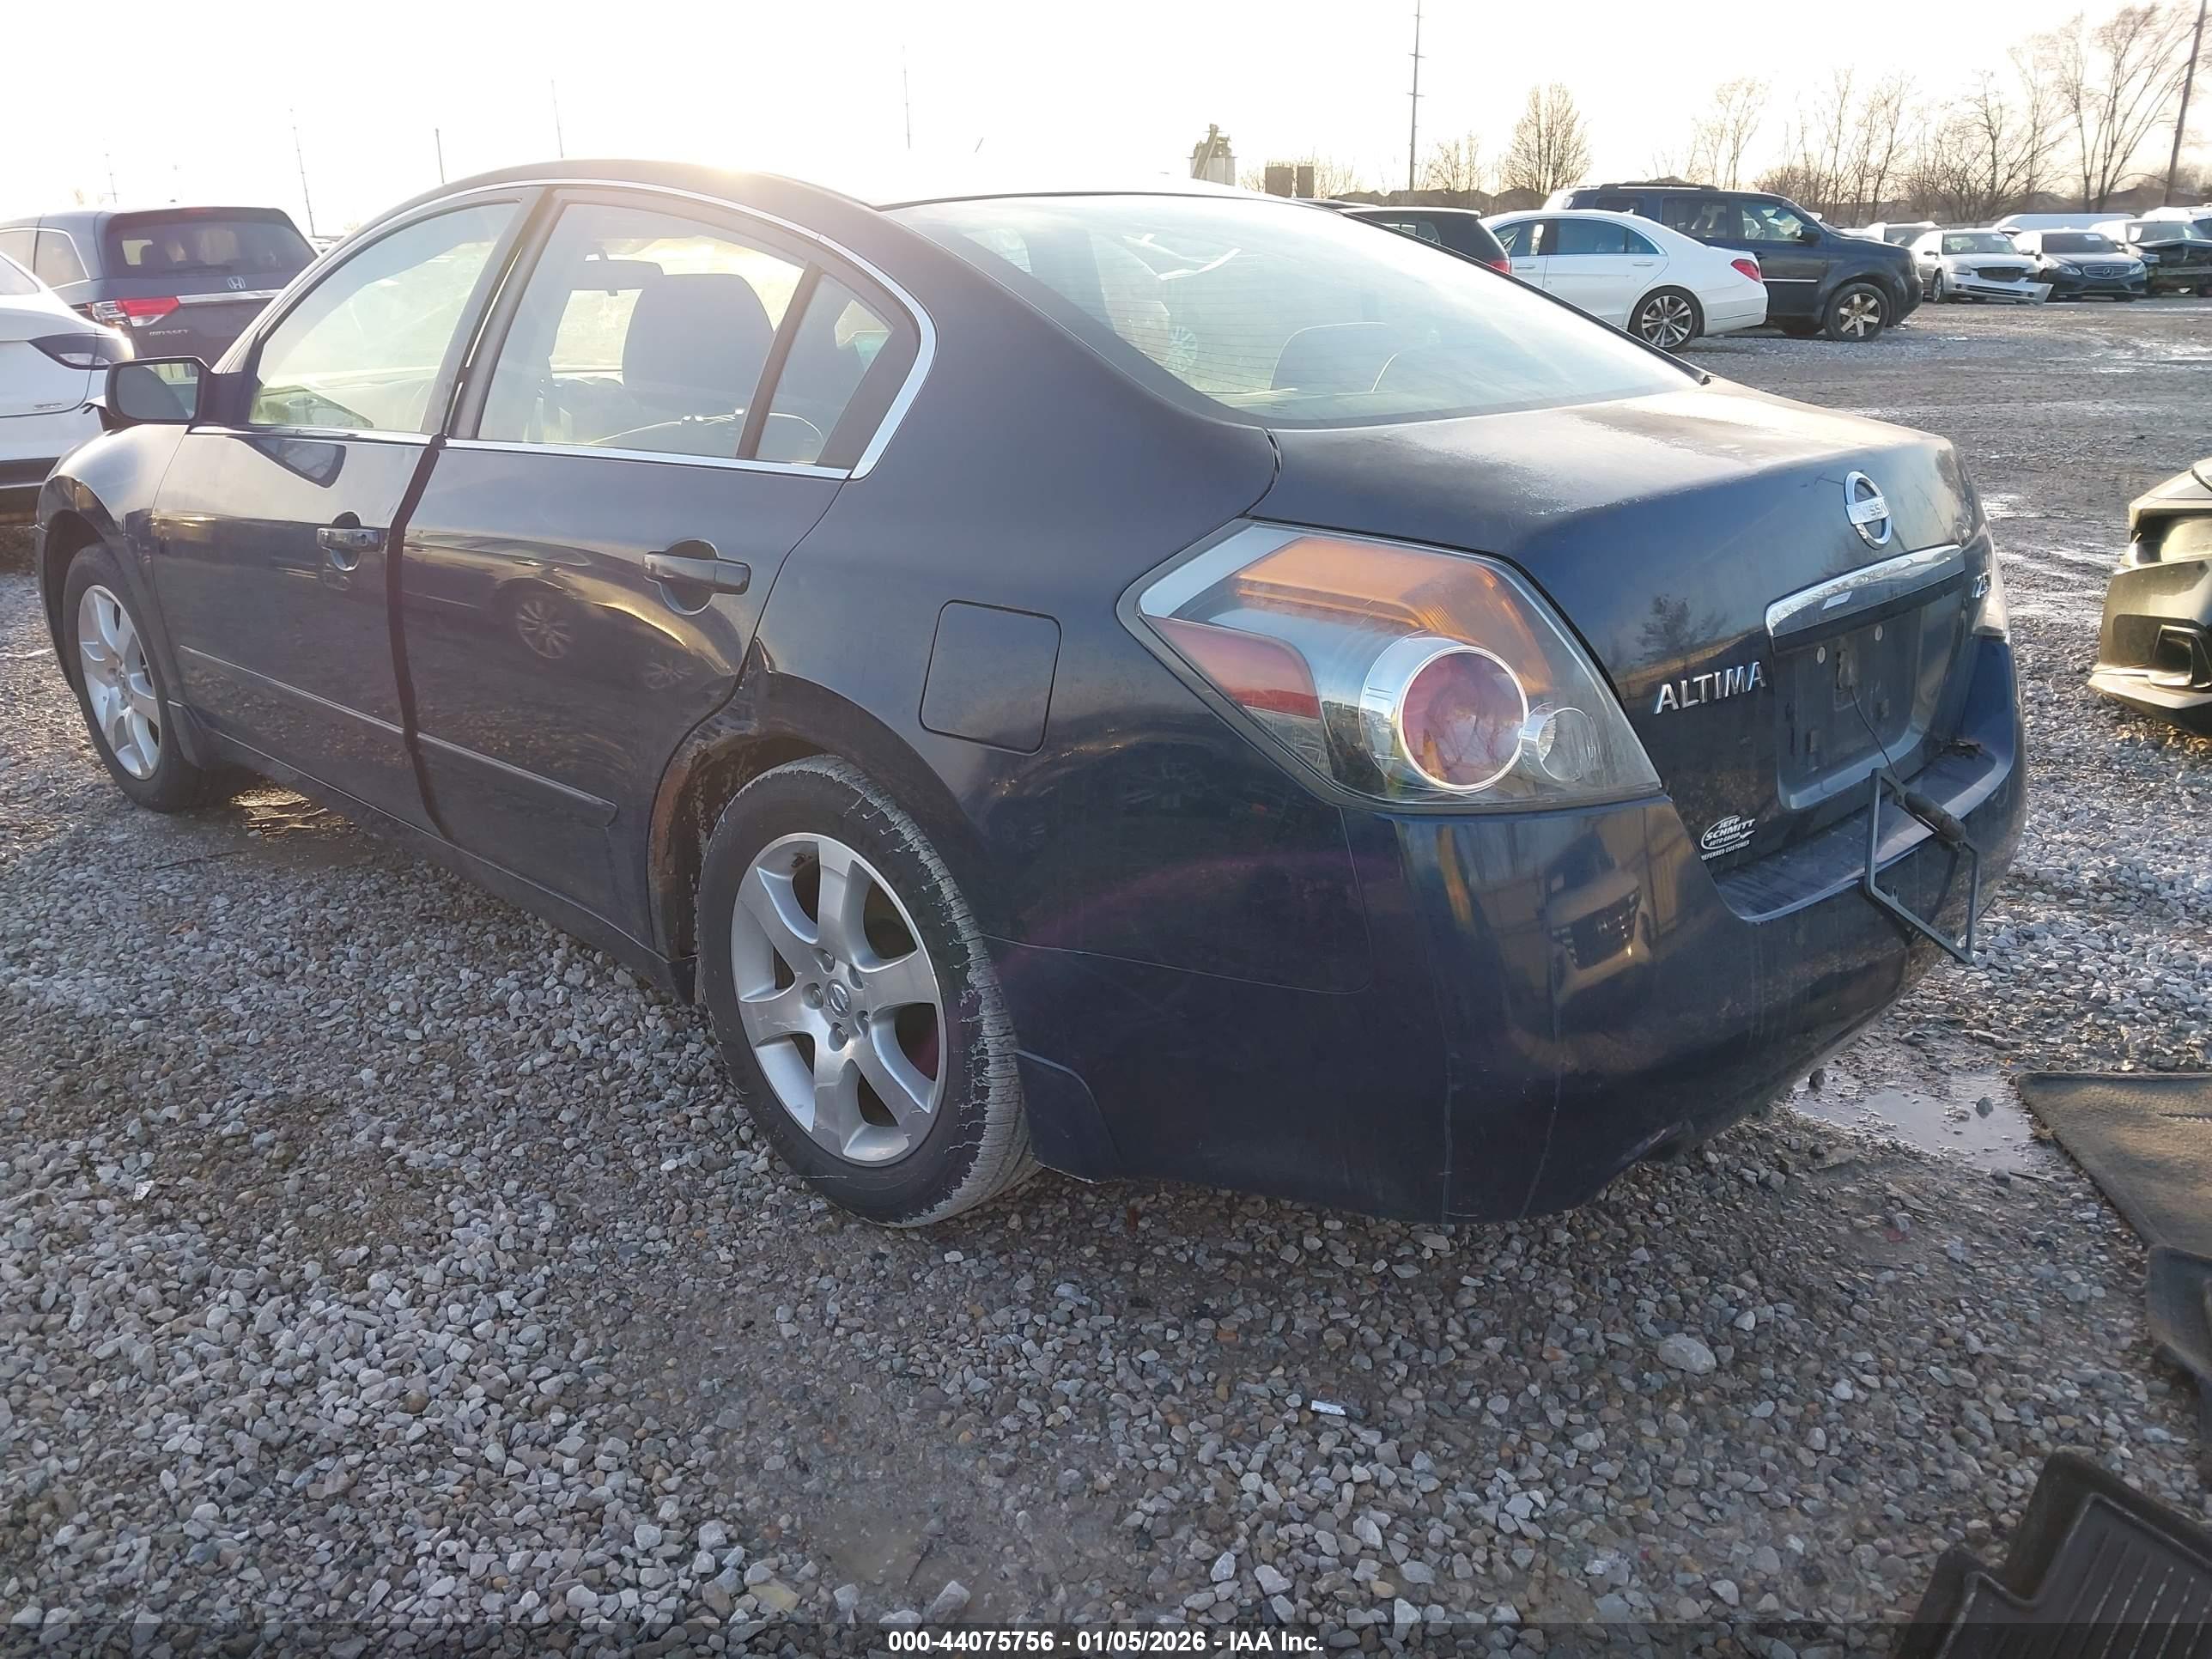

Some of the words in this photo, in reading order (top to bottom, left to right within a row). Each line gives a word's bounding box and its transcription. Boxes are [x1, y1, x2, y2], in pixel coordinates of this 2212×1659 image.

[1652, 660, 1766, 714] ALTIMA
[1705, 818, 1755, 841] SCHMITT
[1718, 817, 1741, 829] JEFF
[1709, 837, 1723, 846] AUTO
[1726, 840, 1750, 853] CUSTOMER
